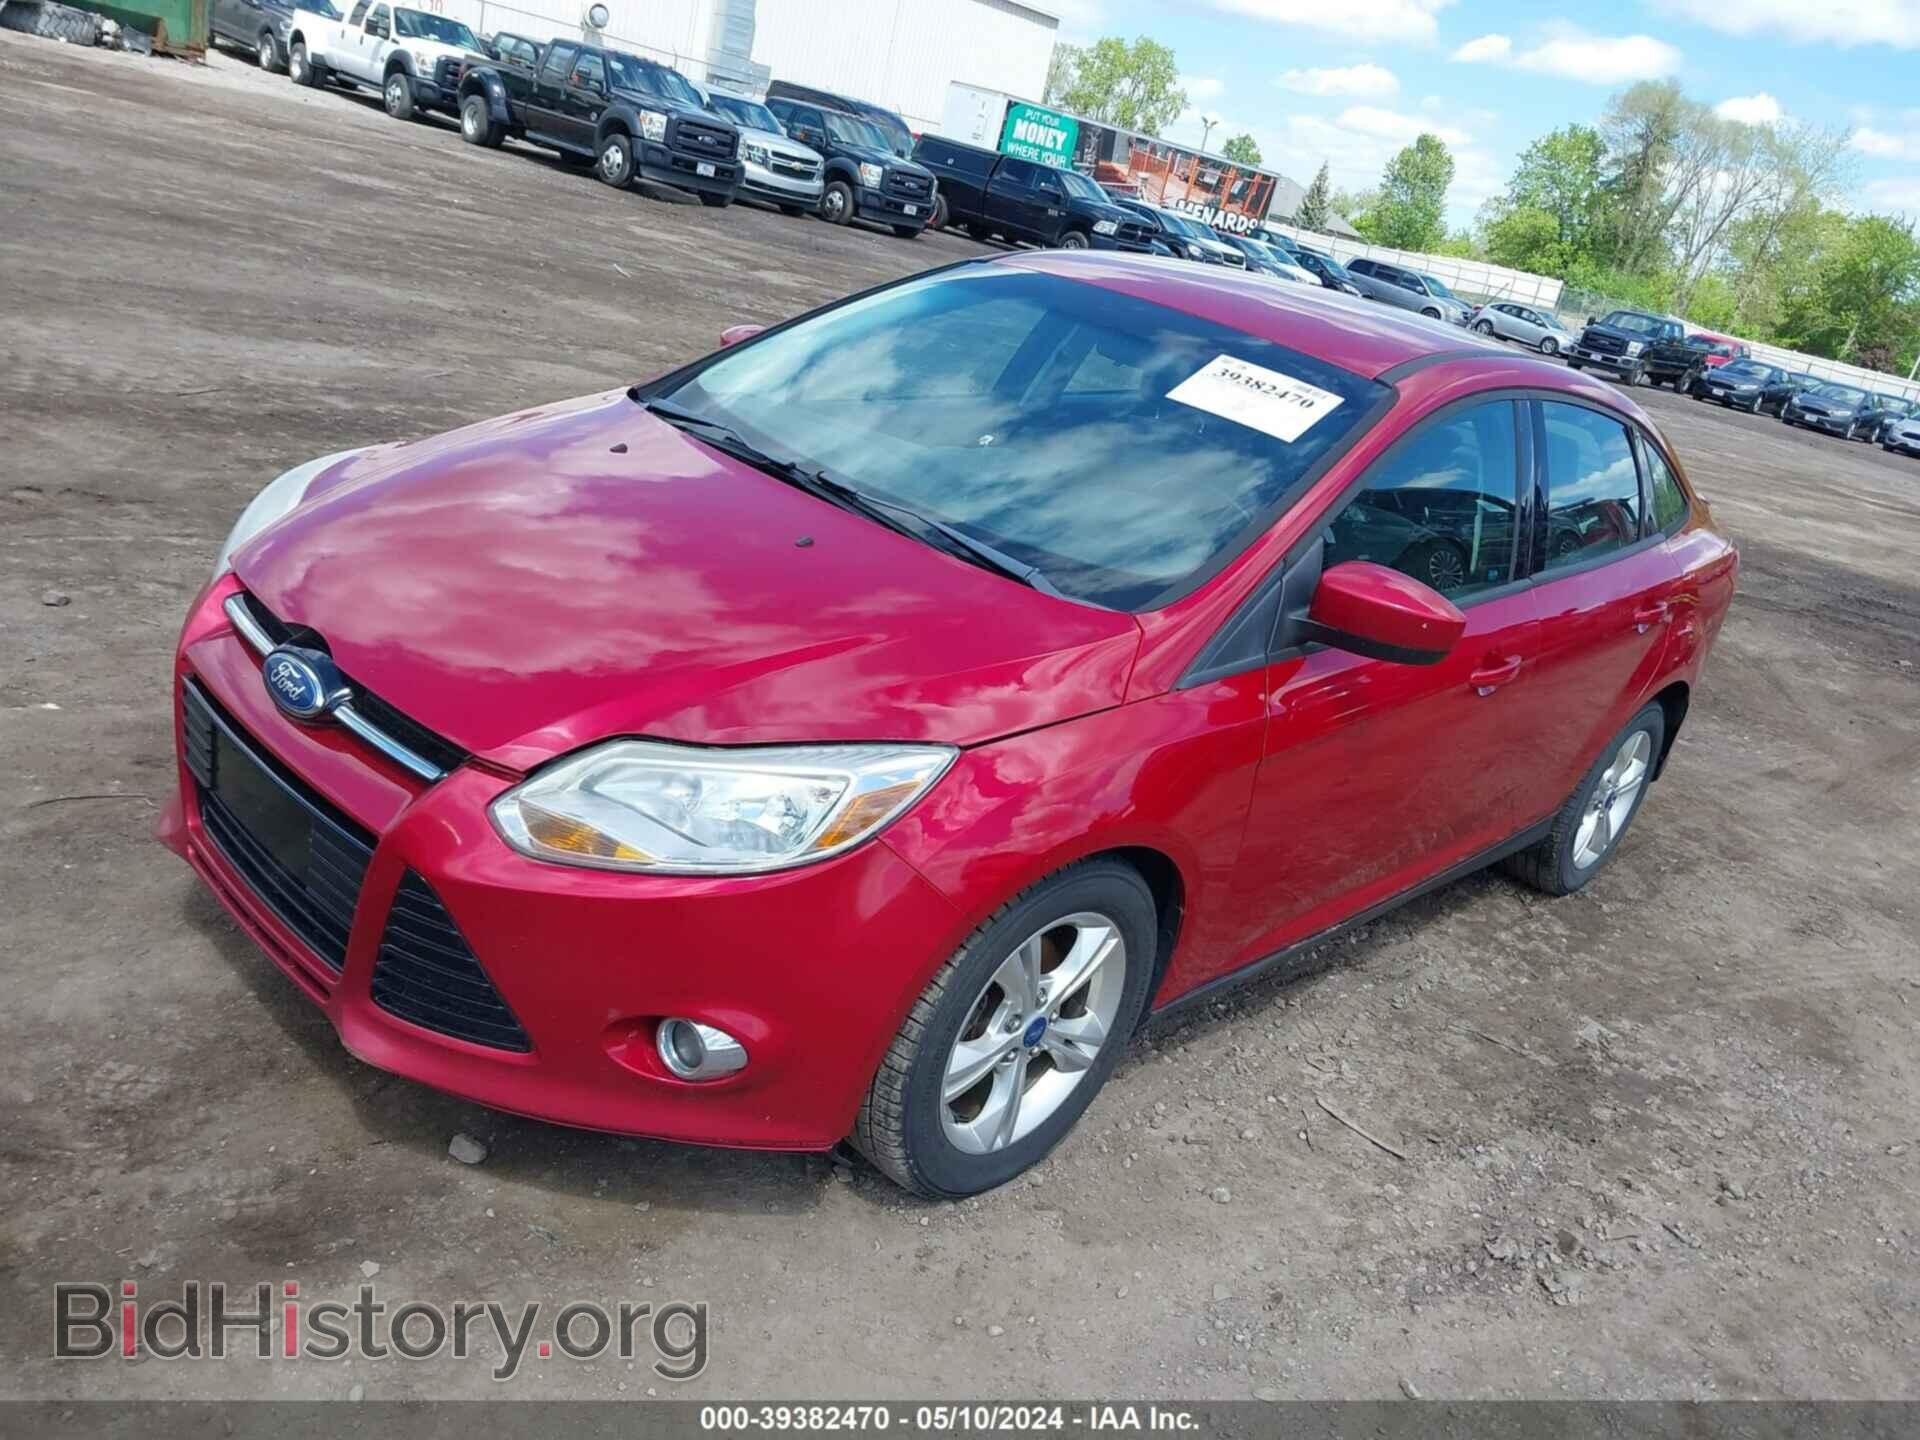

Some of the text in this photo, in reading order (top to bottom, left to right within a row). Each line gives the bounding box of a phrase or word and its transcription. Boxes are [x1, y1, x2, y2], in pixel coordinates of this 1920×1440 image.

[1024, 108, 1061, 127] PUT YOUR
[1012, 118, 1068, 152] MONEY
[1007, 141, 1067, 169] WHERE YOUR
[1220, 368, 1315, 408] 39382470
[269, 660, 306, 701] Ford
